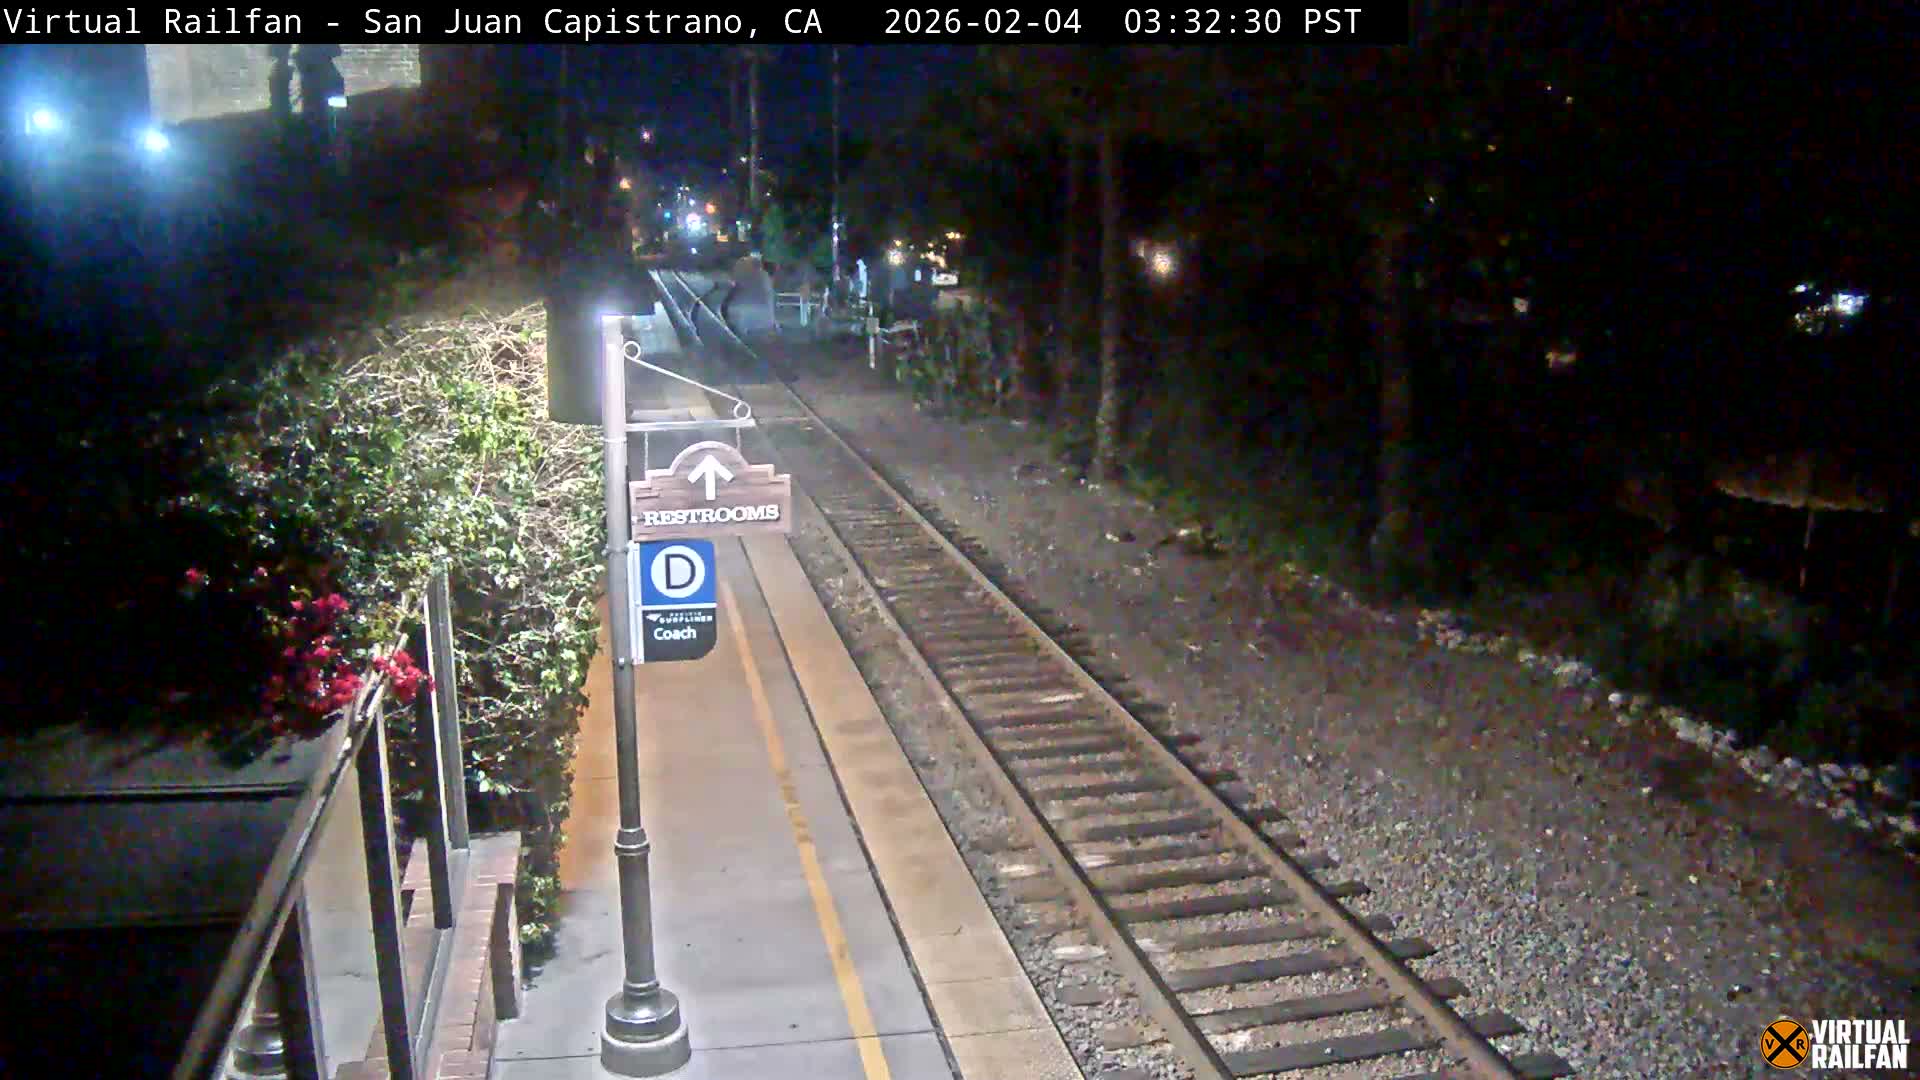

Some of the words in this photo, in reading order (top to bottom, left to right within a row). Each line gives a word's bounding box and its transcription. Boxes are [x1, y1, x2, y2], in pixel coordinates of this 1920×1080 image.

[642, 504, 780, 527] RESTROOMS
[664, 553, 696, 590] D
[653, 625, 697, 641] Coach
